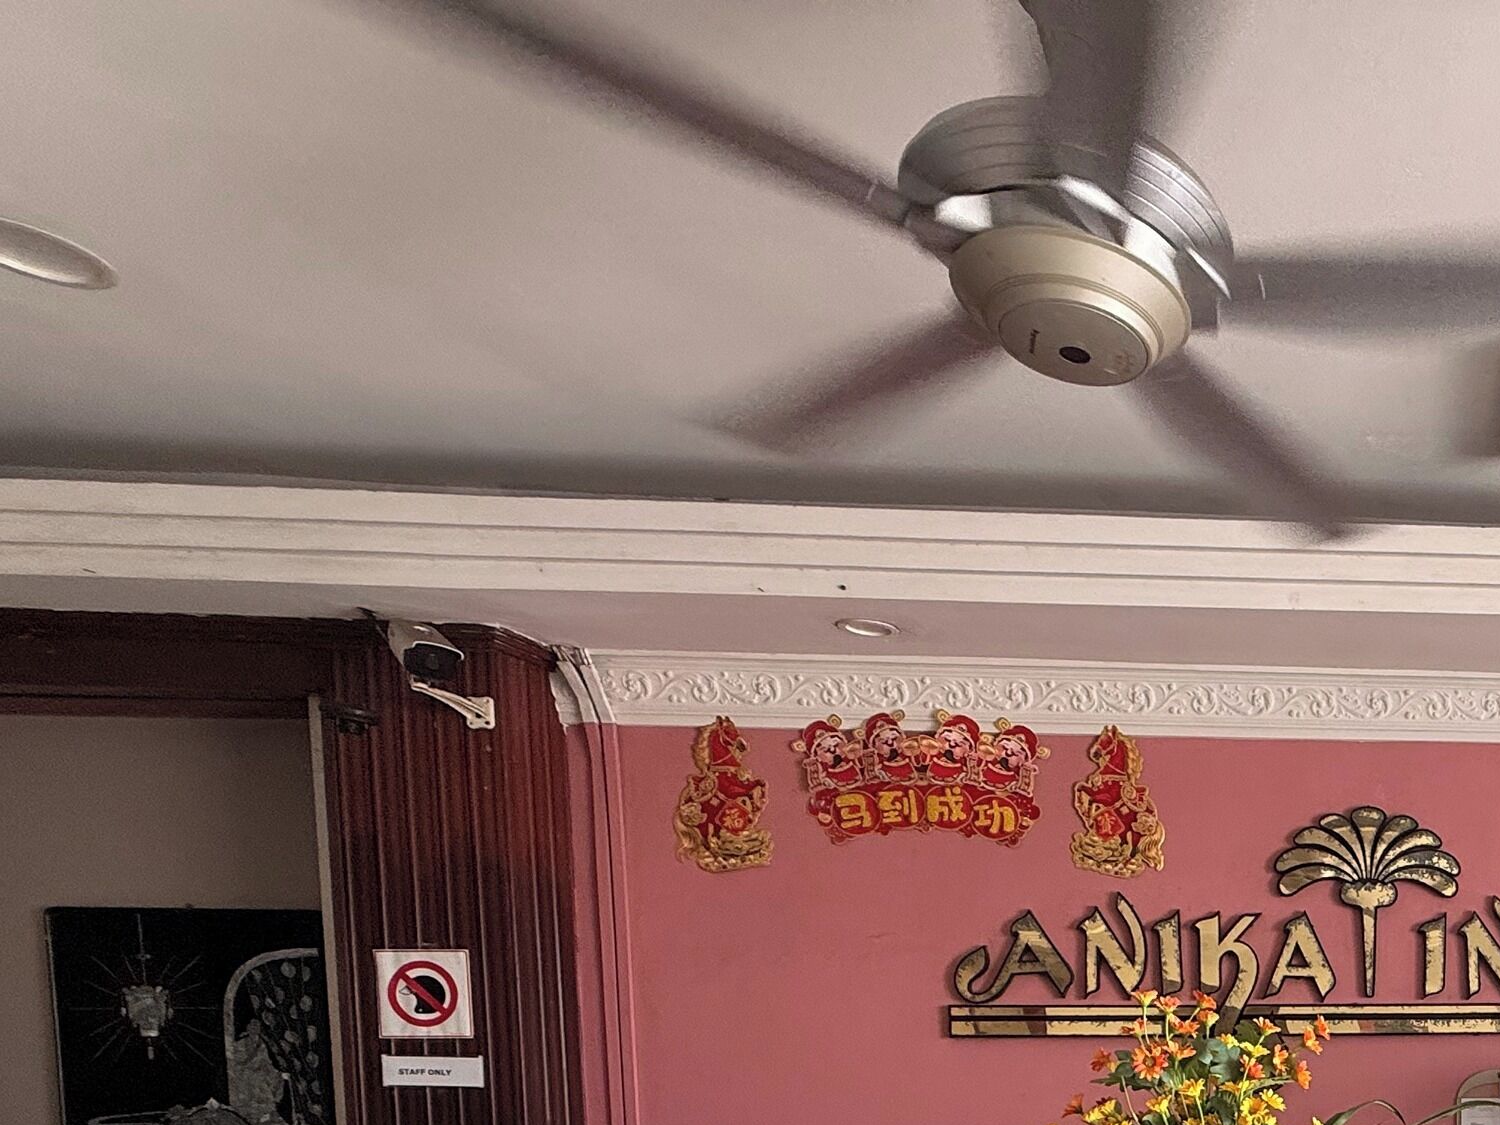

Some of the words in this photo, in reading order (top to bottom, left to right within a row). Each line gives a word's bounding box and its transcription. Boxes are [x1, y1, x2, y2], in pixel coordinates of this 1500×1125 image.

[835, 787, 1016, 834] 马到成功
[955, 892, 1336, 1036] ANIKA
[398, 1068, 426, 1076] STAFF
[428, 1068, 453, 1076] ONLY
